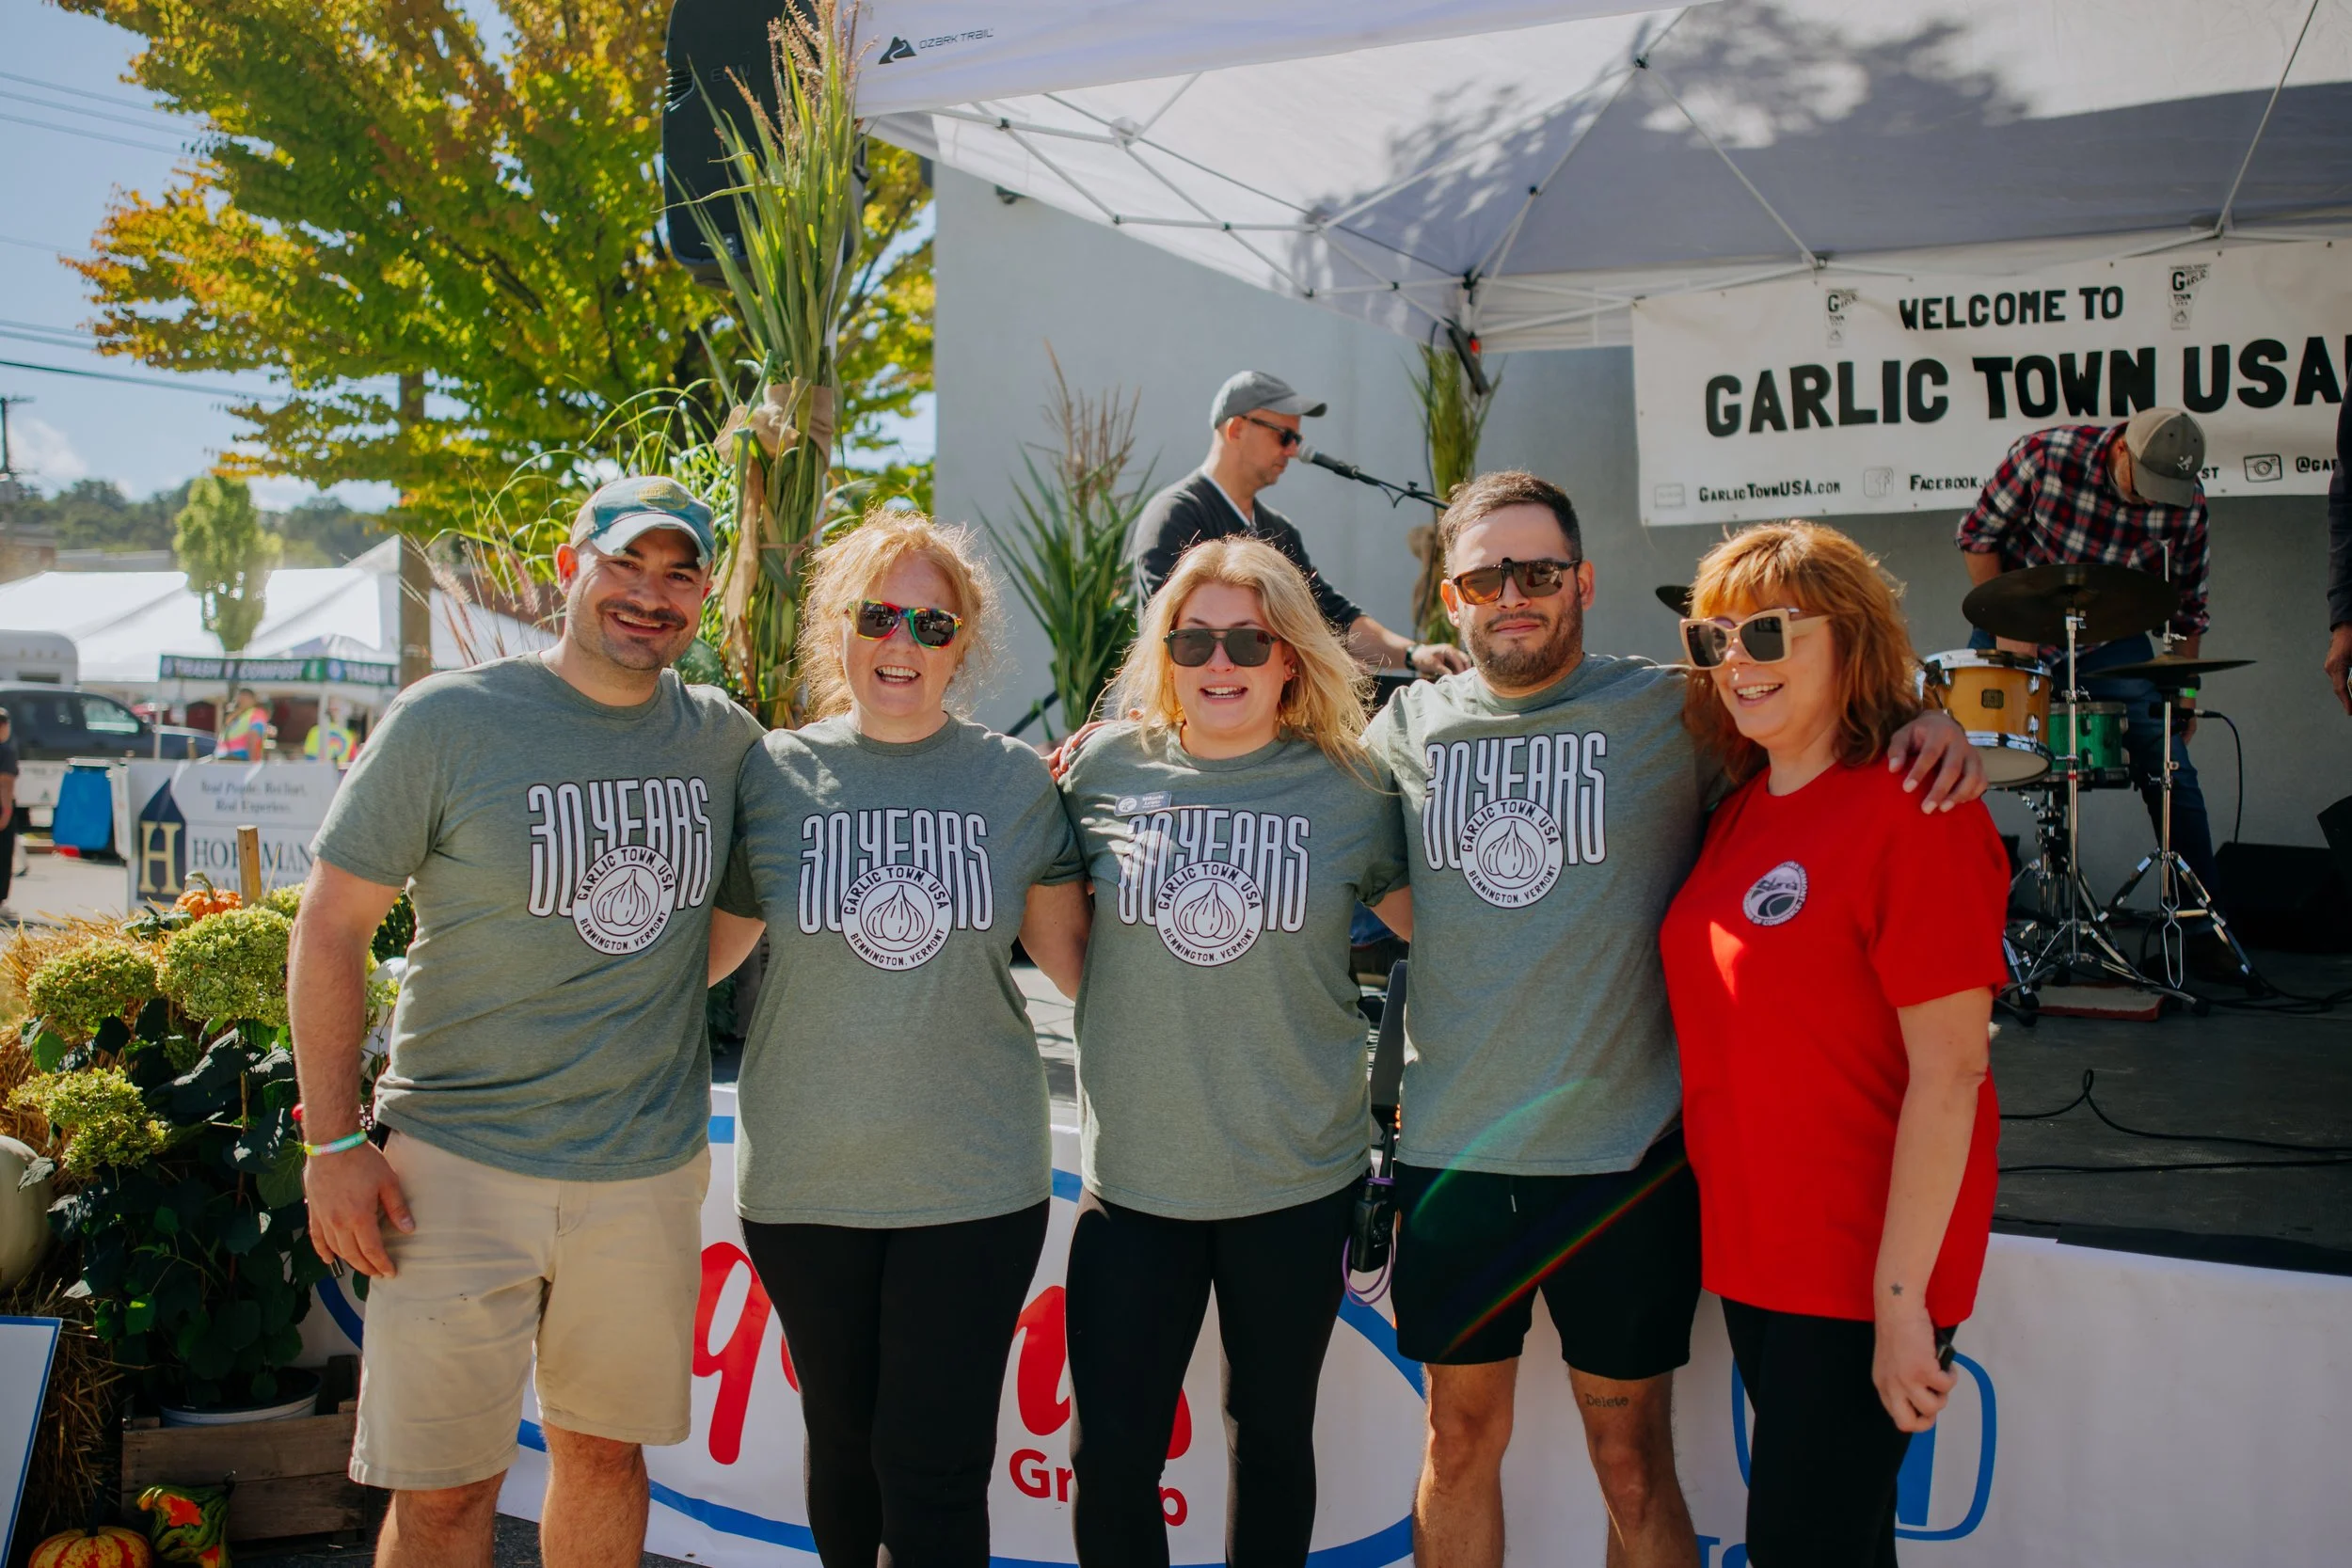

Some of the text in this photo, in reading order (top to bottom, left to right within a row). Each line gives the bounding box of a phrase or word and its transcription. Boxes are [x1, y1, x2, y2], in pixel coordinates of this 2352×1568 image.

[919, 29, 993, 49] OZARK TRAIL
[1899, 286, 2123, 331] WELCOME TO
[1705, 335, 2352, 438] GARLIC TOWN USA
[175, 659, 389, 683] TRASH COMPOST TRASH
[1422, 731, 1607, 871] 30 YEARS
[527, 776, 713, 918] 30 YEARS
[1461, 807, 1496, 852] GARLIC
[1539, 816, 1559, 845] USA
[138, 821, 183, 894] H
[576, 854, 617, 901] GARLIC
[657, 863, 675, 893] USA
[798, 808, 993, 935] 30 YEARS
[1118, 808, 1311, 933] 30 YEARS
[843, 871, 882, 916] GARLIC
[929, 880, 949, 910] USA
[1158, 868, 1197, 911] GARLIC
[1241, 880, 1261, 910] USA
[1524, 864, 1558, 900] VERMONT
[634, 910, 667, 946] VERMONT
[910, 928, 945, 962] VERMONT
[1220, 928, 1255, 959] VERMONT
[1584, 1393, 1629, 1408] Delete
[1009, 1449, 1188, 1528] Grp
